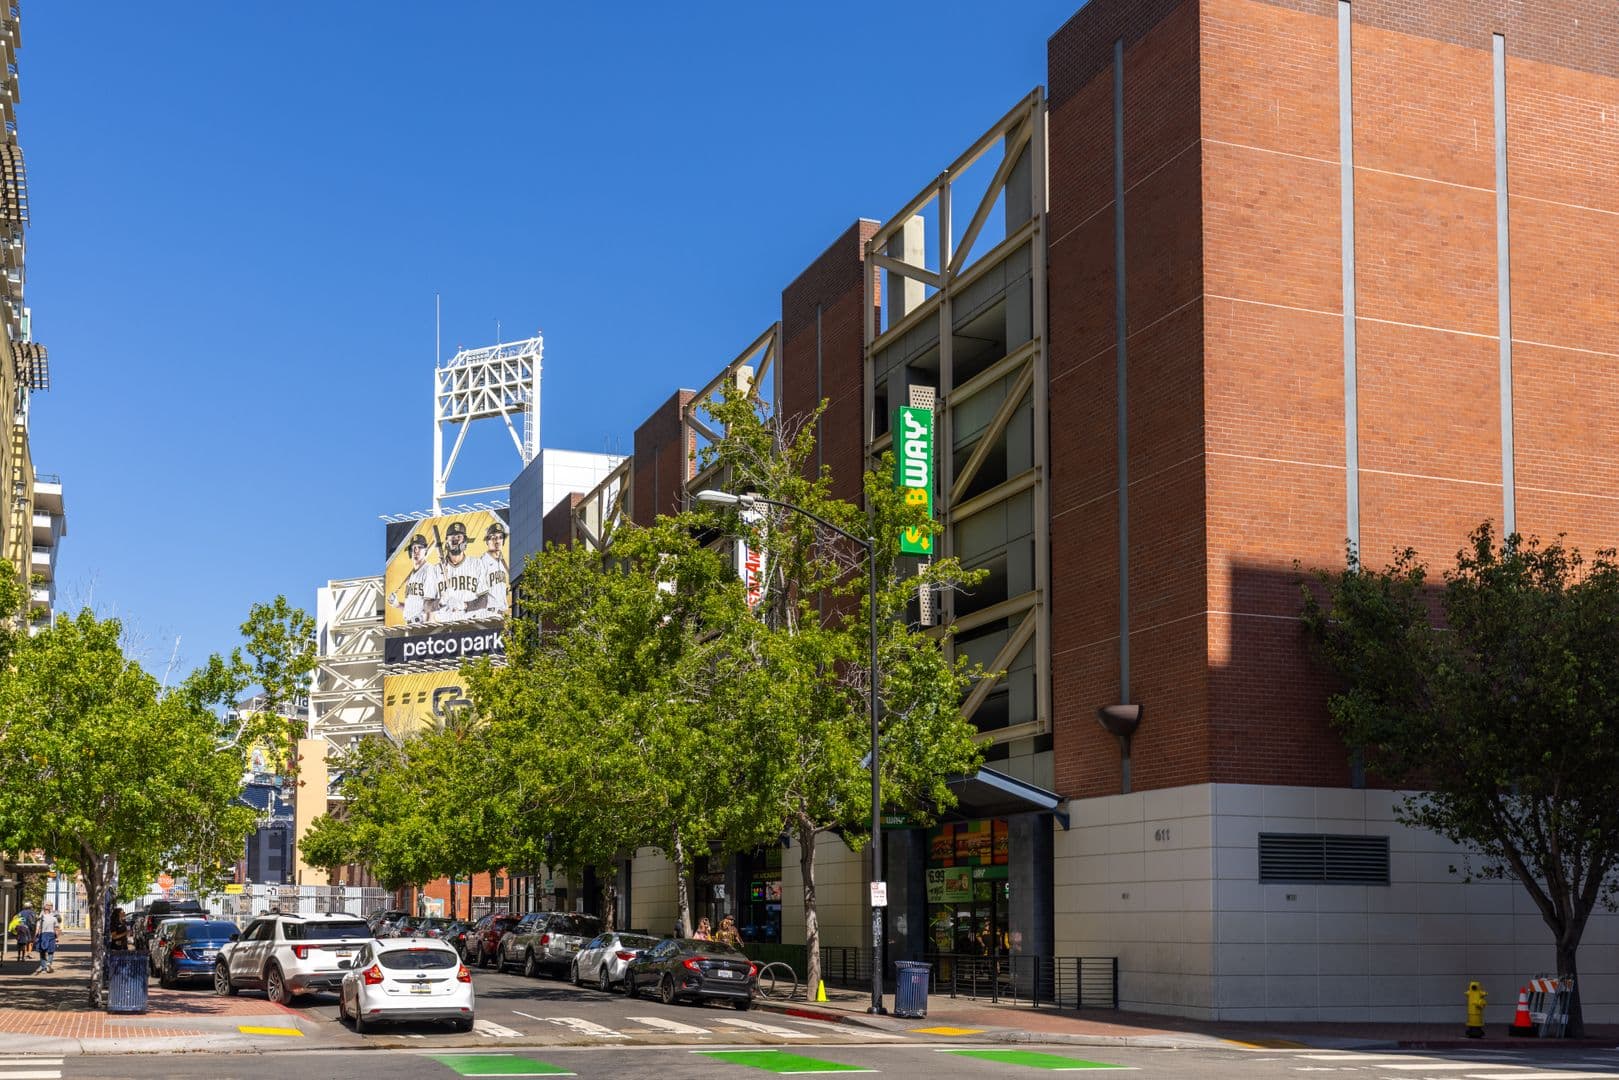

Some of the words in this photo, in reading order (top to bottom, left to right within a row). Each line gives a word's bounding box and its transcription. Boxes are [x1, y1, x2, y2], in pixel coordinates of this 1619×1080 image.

[904, 410, 929, 550] SBWAY
[403, 637, 457, 661] petco
[461, 632, 505, 656] park
